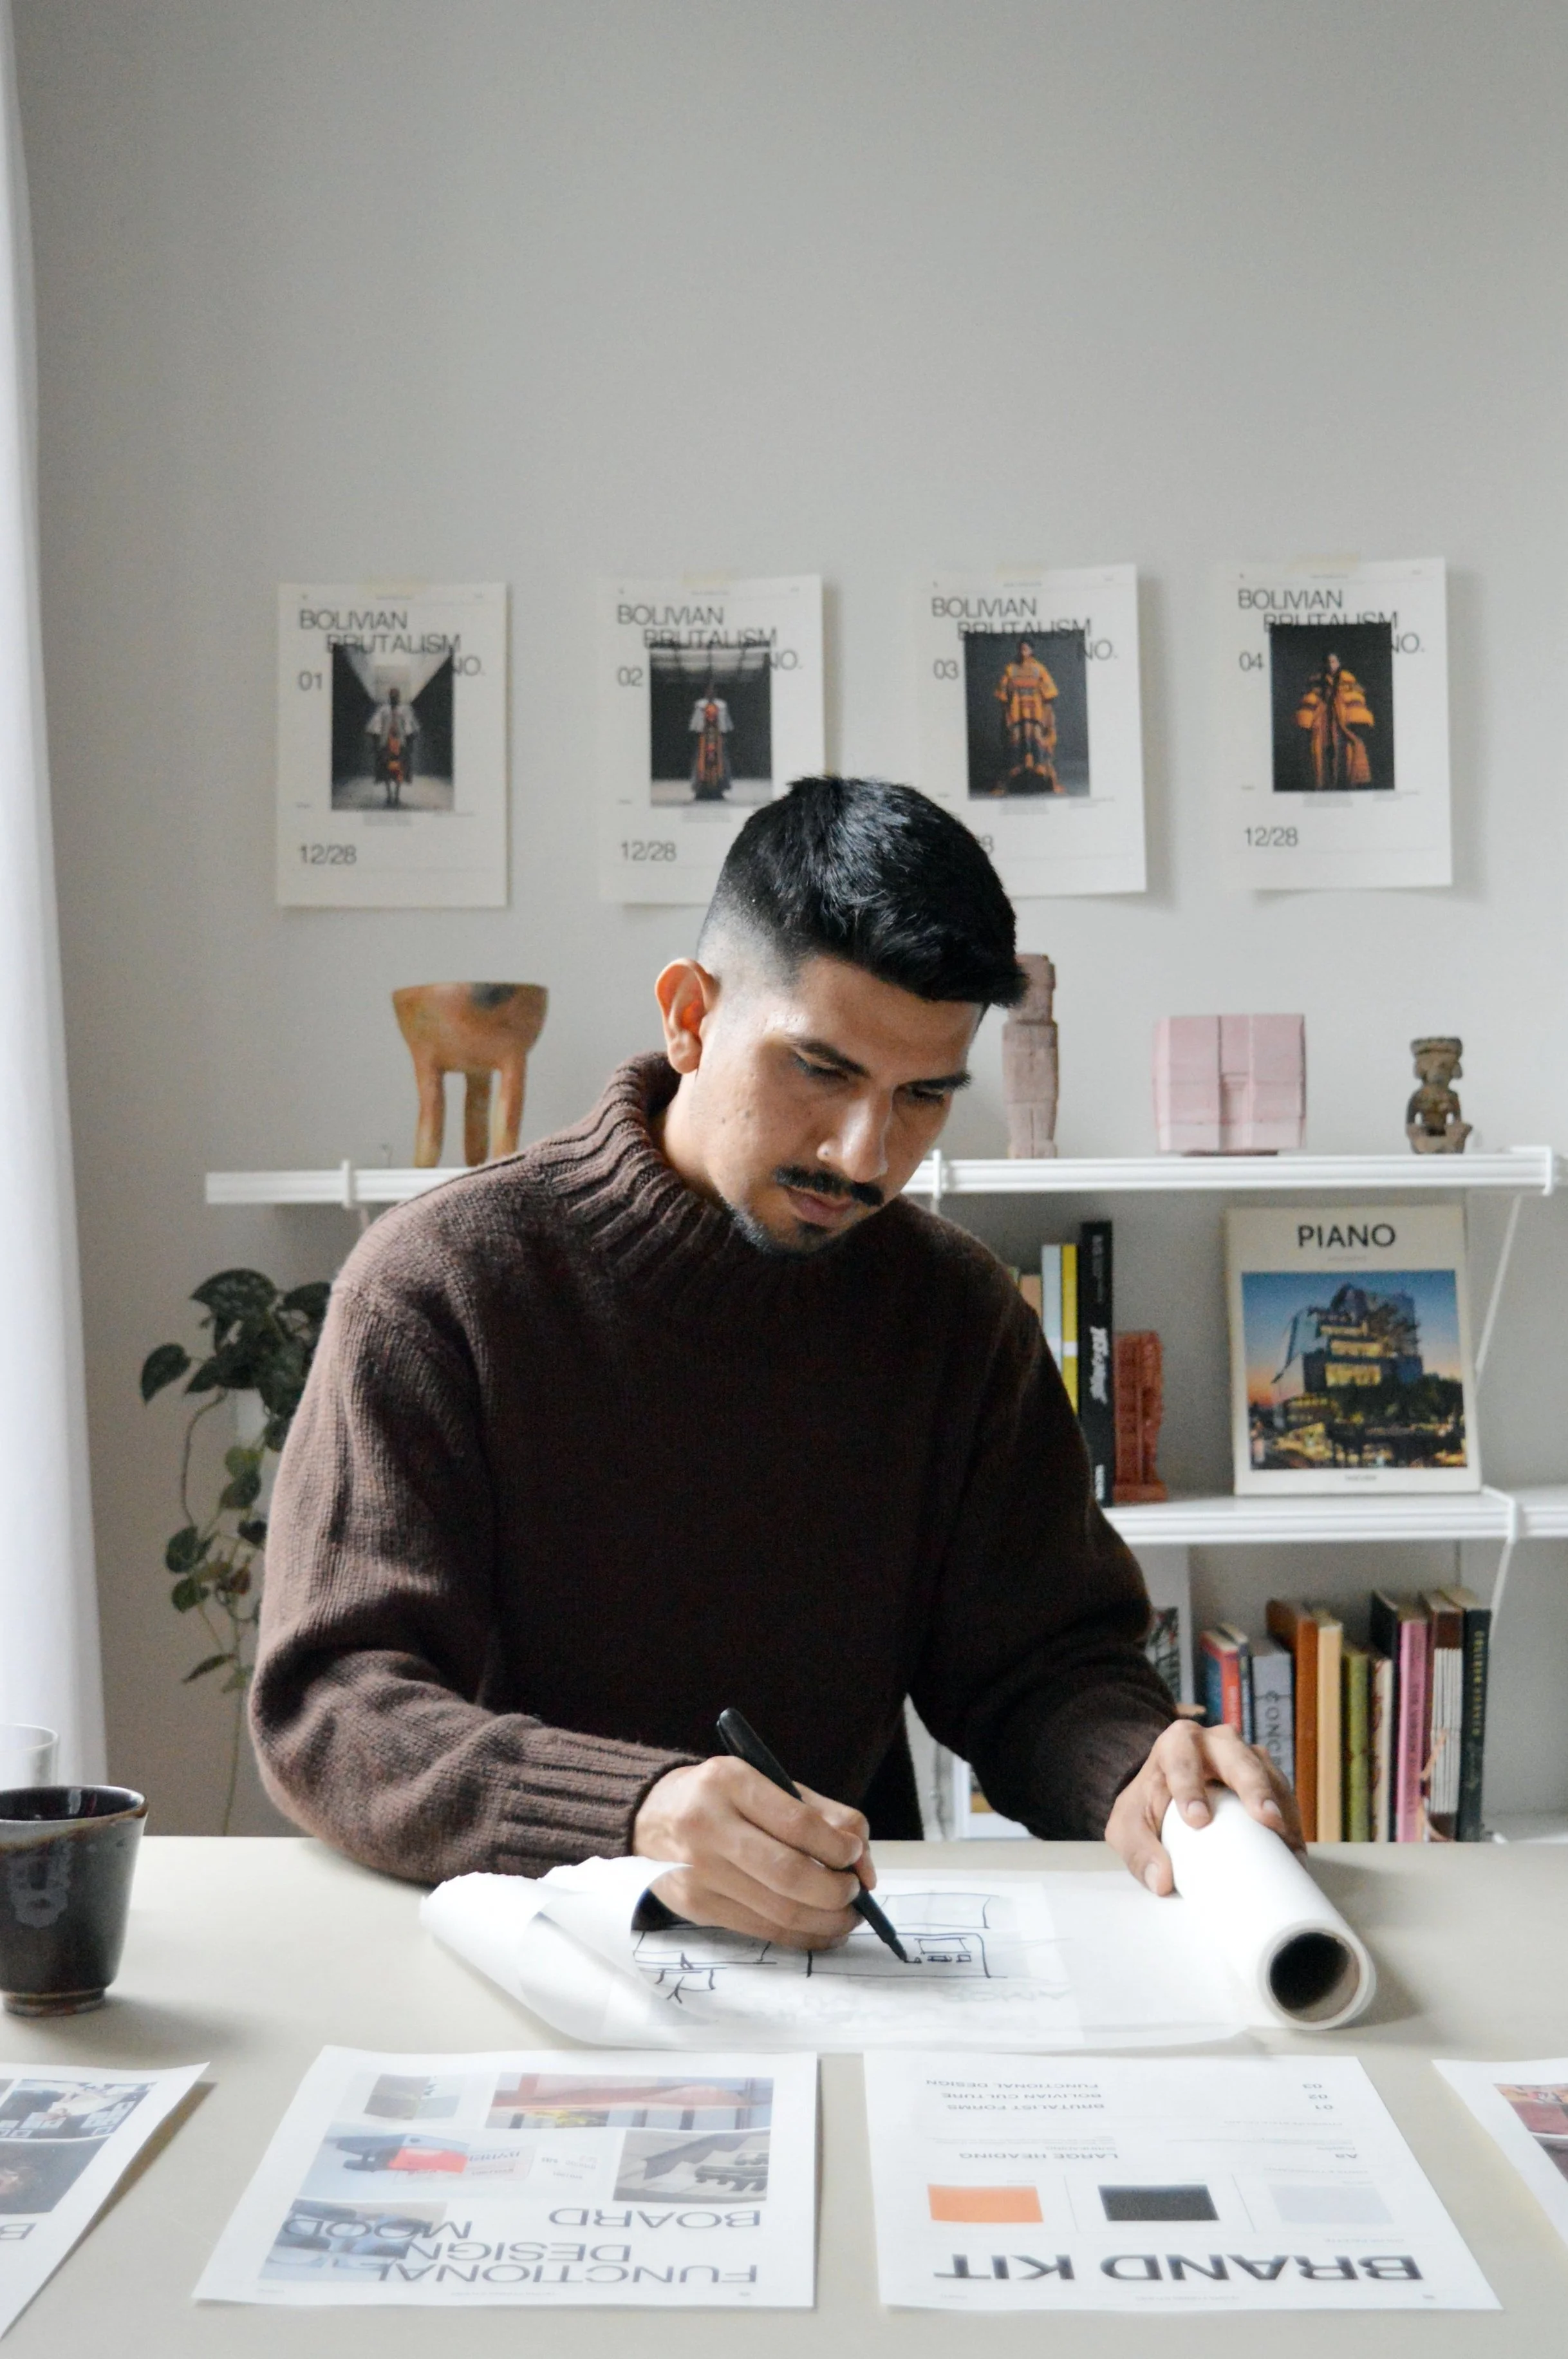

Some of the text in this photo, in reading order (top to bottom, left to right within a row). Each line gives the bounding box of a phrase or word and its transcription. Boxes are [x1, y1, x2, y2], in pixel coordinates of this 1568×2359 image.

[931, 597, 1036, 618] BOLIVIAN
[1238, 588, 1342, 610] BOLIVIAN
[299, 609, 407, 630] BOLIVIAN
[617, 604, 724, 626] BOLIVIAN
[933, 659, 959, 680] 03
[1238, 651, 1264, 672] 04
[298, 670, 322, 691] 01
[617, 666, 643, 687] 02
[1244, 827, 1298, 847] 12/28
[299, 844, 357, 865] 12/28
[620, 841, 677, 863] 12/28
[1297, 1223, 1396, 1248] PIANO
[926, 2080, 988, 2089] DESIGN
[548, 2208, 761, 2228] BOARD
[283, 2219, 473, 2239] MOOD
[400, 2241, 633, 2262] DESIGN
[360, 2262, 758, 2283] FUNCTIONAL
[933, 2254, 1424, 2281] BRAND KIT
